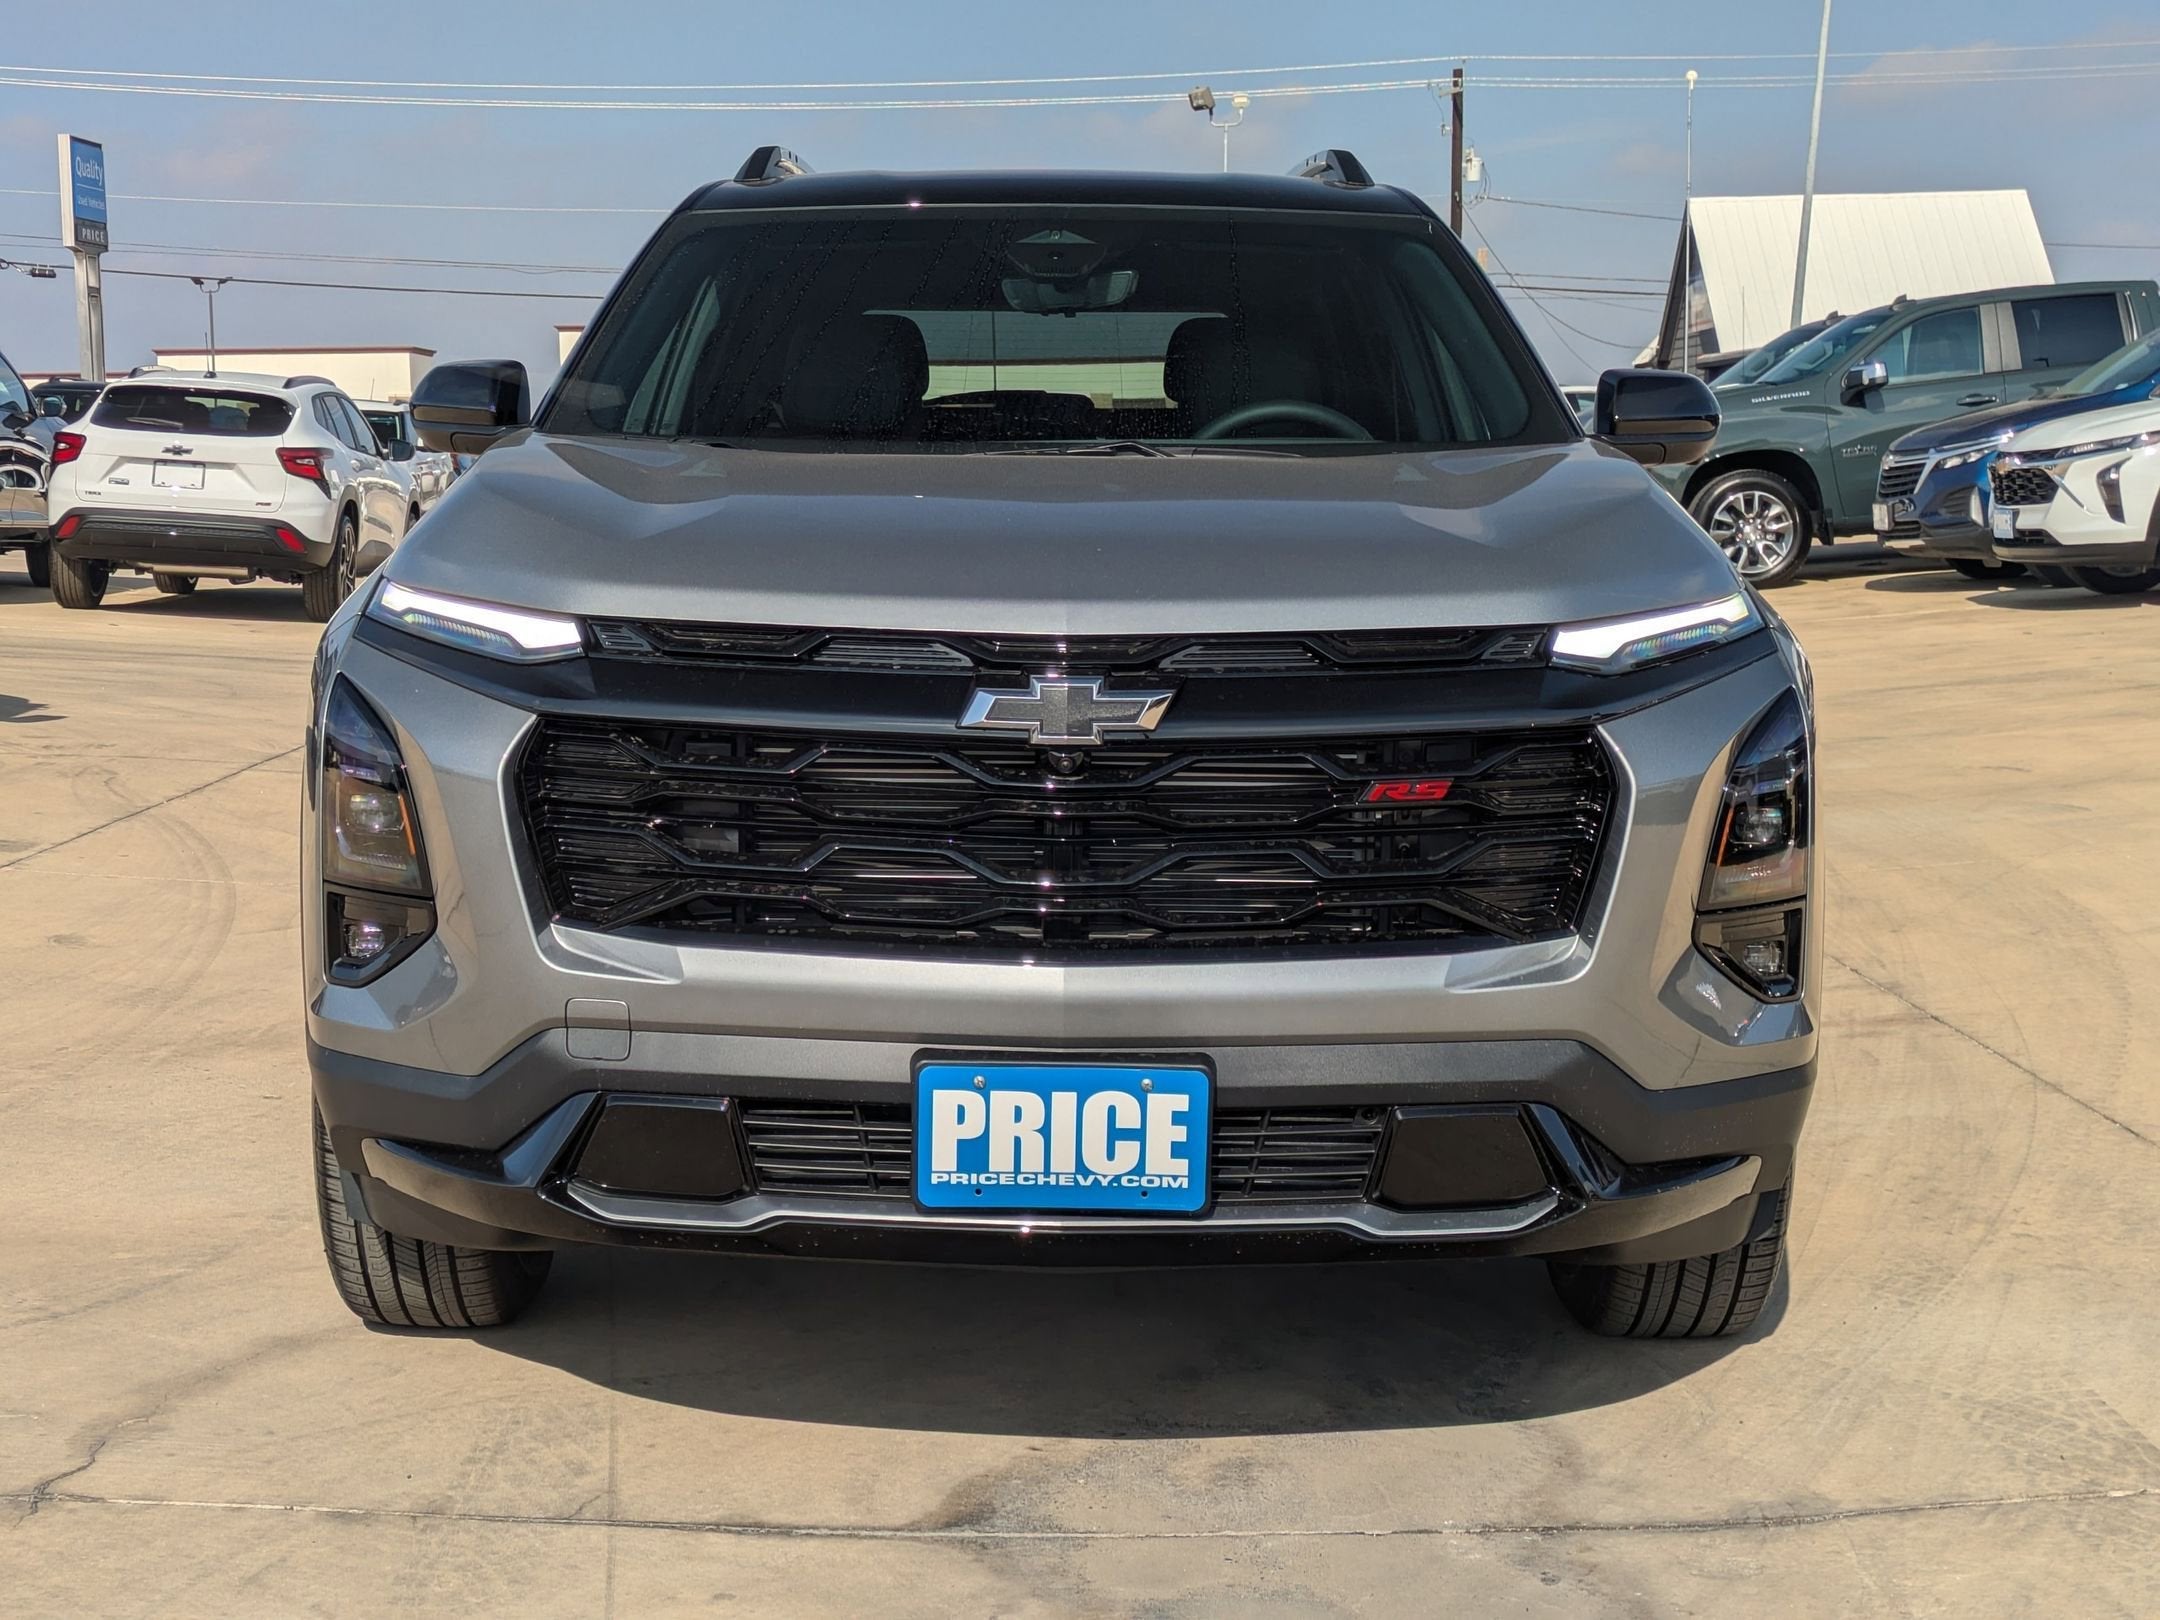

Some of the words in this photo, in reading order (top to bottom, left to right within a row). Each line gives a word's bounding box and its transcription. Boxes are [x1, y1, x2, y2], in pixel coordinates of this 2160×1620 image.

[75, 156, 103, 186] Quality
[82, 227, 105, 242] PRICE
[1751, 390, 1810, 403] SILVERADO
[1367, 781, 1452, 801] RS
[930, 1089, 1190, 1176] PRICE
[930, 1172, 1189, 1189] PRICECHEVY.COM
